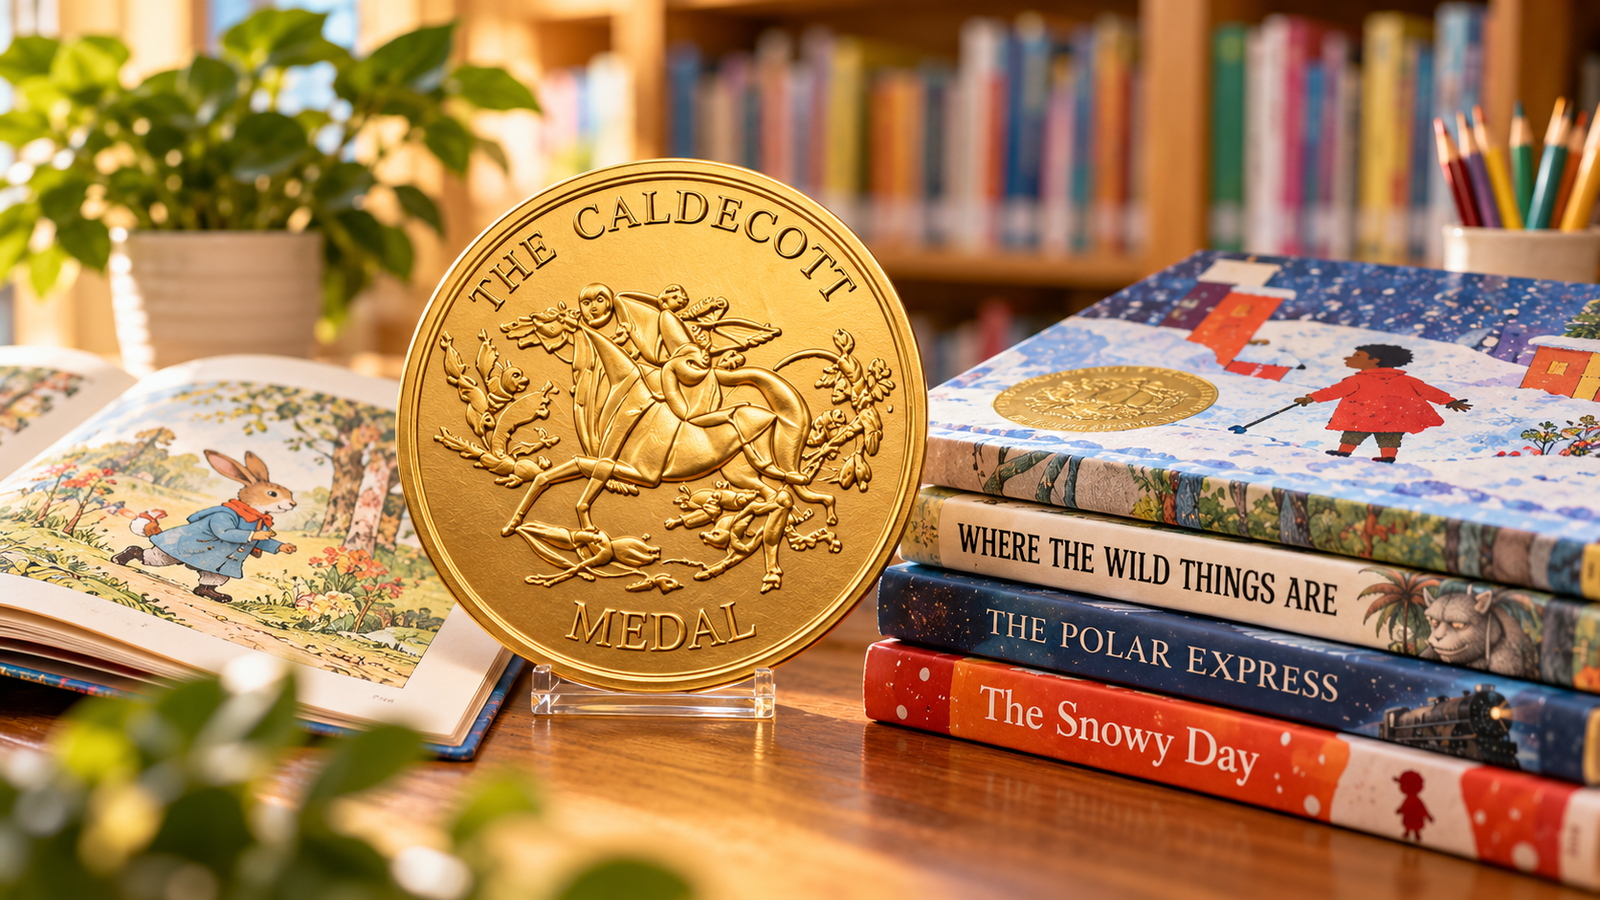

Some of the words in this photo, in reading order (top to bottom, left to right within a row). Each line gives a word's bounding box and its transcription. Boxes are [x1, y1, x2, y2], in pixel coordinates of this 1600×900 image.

[468, 229, 558, 311] THE
[573, 190, 858, 302] CALDECOTT
[958, 523, 1041, 564] WHERE
[1049, 537, 1096, 574] THE
[1103, 546, 1171, 585] WILD
[1179, 558, 1276, 604] THINGS
[1284, 577, 1339, 616] ARE
[565, 600, 757, 652] MEDAL
[985, 608, 1048, 645] THE
[1059, 622, 1172, 669] POLAR
[1186, 646, 1339, 703] EXPRESS
[979, 685, 1044, 731] The
[1056, 700, 1175, 767] Snowy
[1184, 727, 1260, 786] Day
